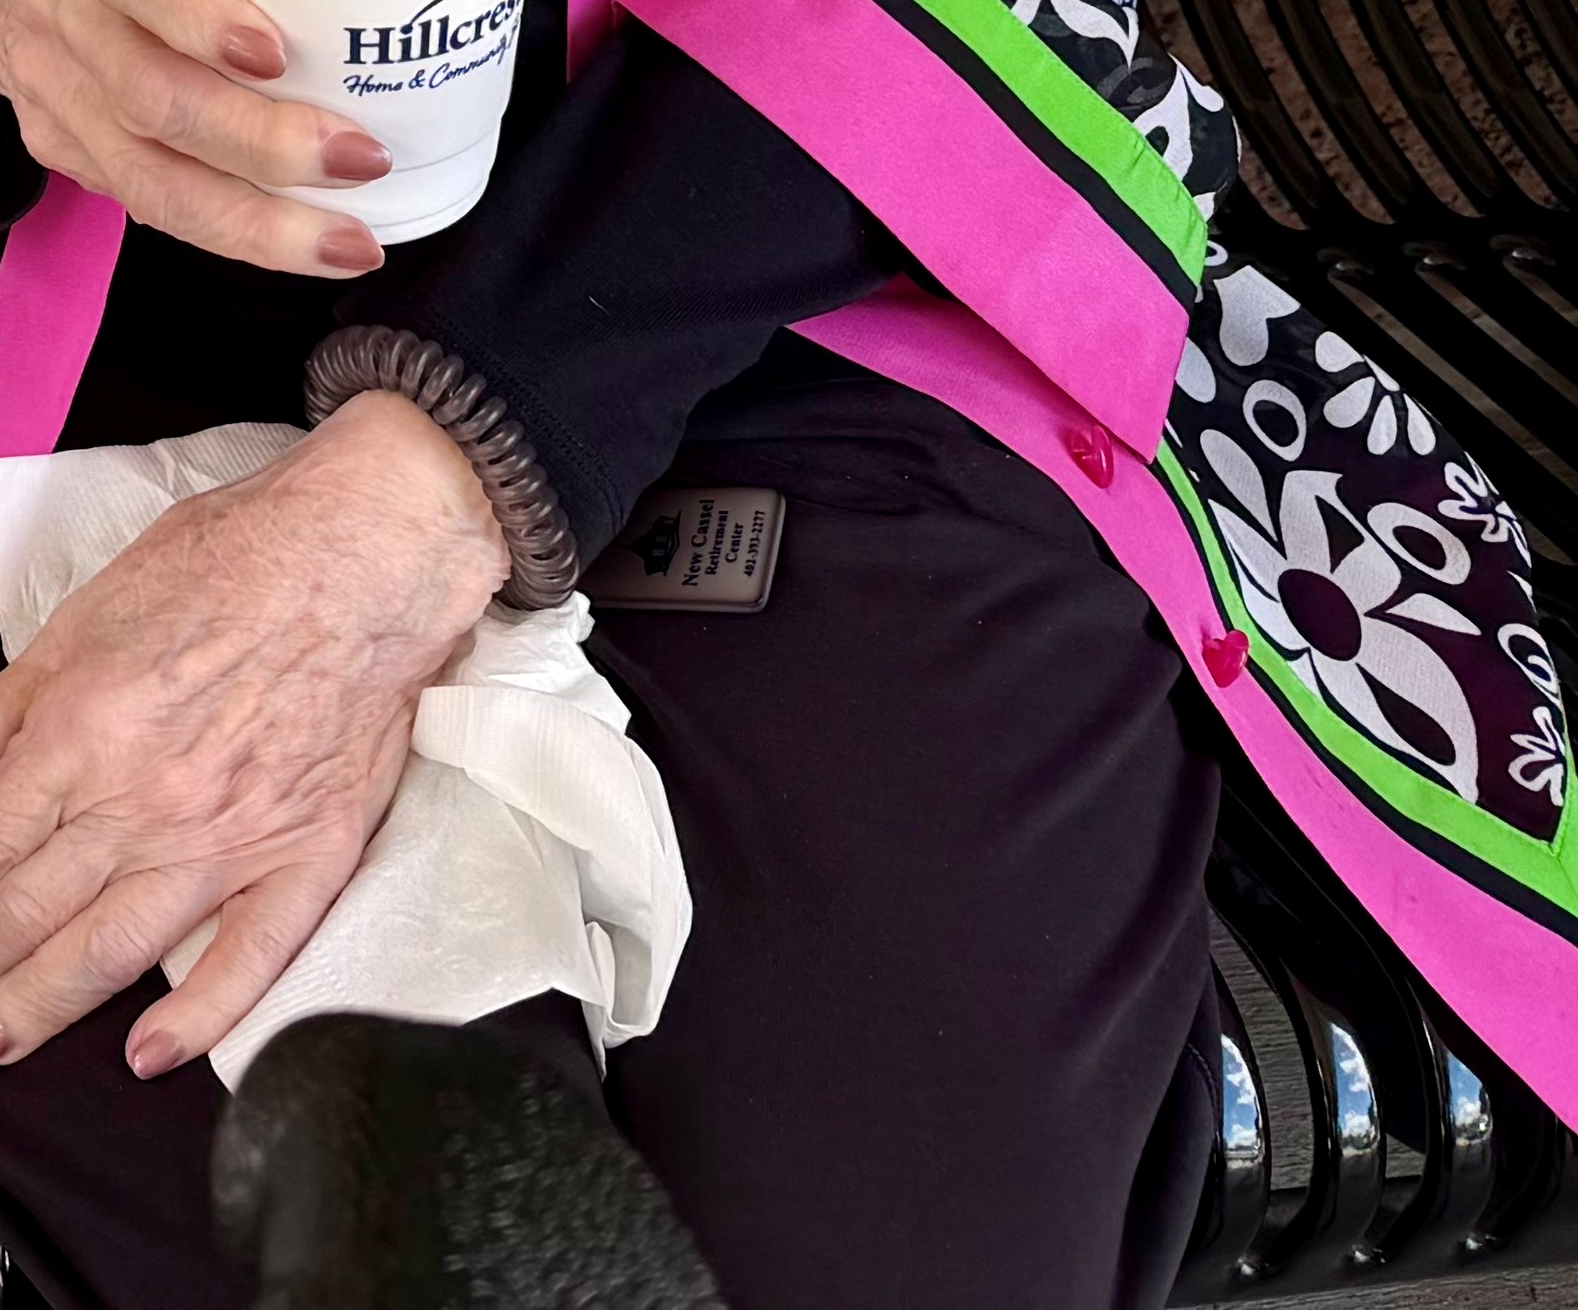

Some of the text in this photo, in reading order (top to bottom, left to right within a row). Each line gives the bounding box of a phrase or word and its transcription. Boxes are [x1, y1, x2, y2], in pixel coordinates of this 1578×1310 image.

[343, 74, 403, 96] Home
[408, 69, 425, 89] &
[681, 499, 715, 587] New Cassel
[705, 510, 729, 575] Retirement
[724, 522, 744, 564] Center
